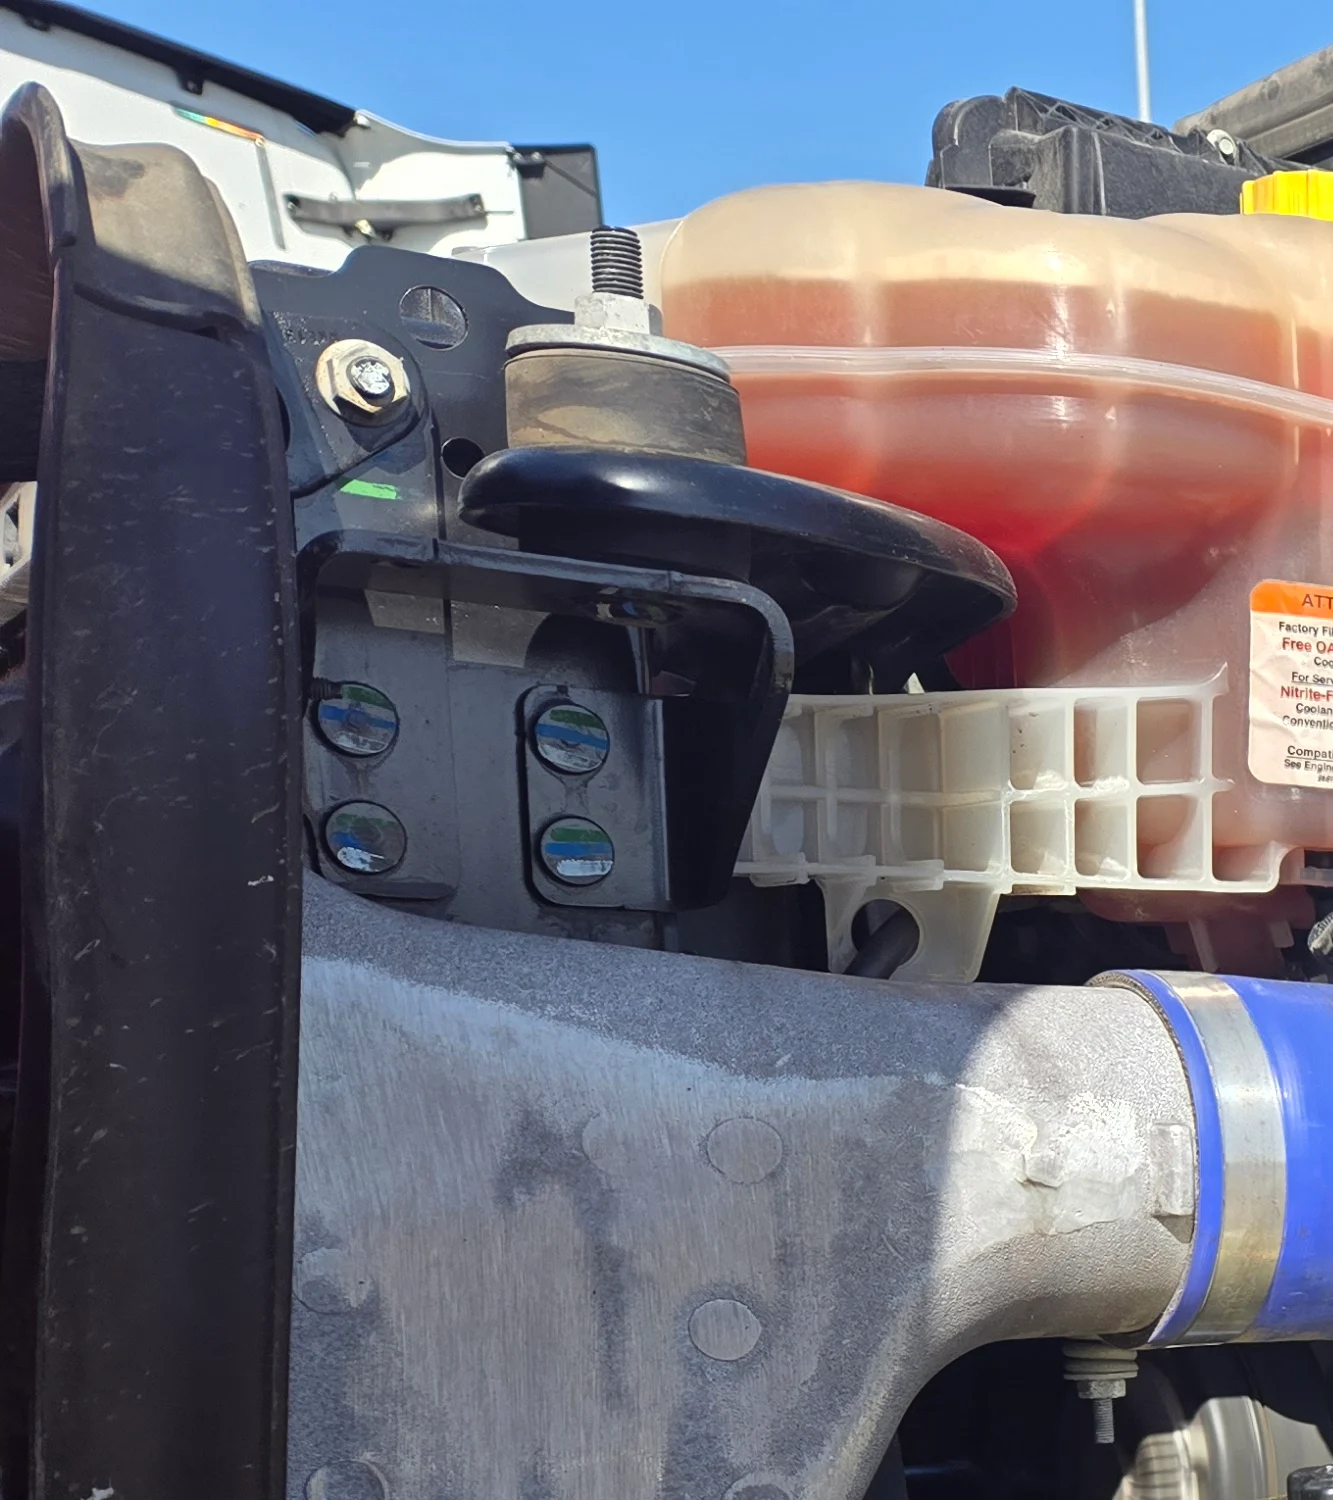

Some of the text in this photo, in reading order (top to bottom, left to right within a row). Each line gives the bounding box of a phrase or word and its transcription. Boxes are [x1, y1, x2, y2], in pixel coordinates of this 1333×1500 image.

[1279, 622, 1319, 637] Factory
[1282, 637, 1312, 653] Free
[1292, 671, 1309, 684] For
[1284, 759, 1302, 770] See
